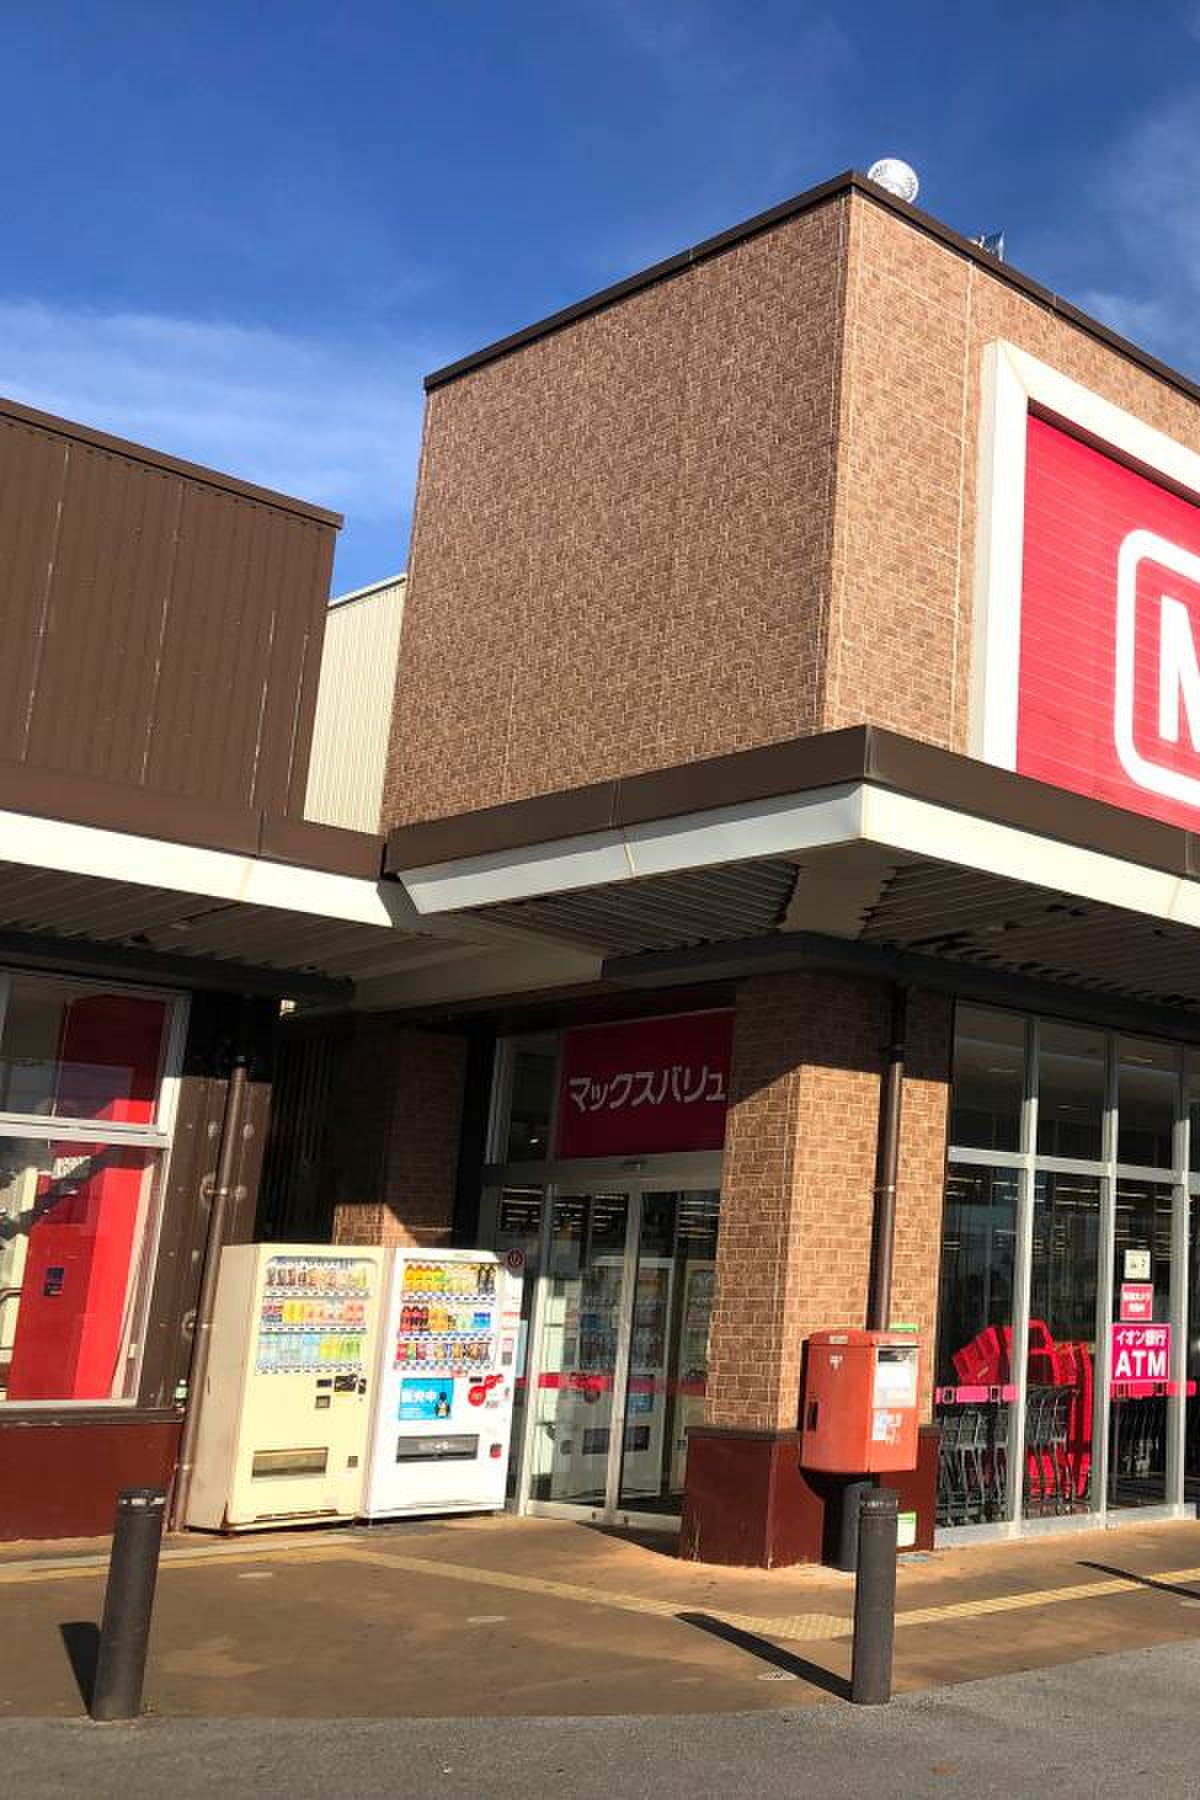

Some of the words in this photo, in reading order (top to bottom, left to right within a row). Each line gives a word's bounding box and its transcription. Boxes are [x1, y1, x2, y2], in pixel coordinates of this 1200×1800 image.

[569, 1065, 726, 1112] マックスバリュ
[1116, 1328, 1166, 1347] イオン銀行
[1115, 1350, 1166, 1377] ATM
